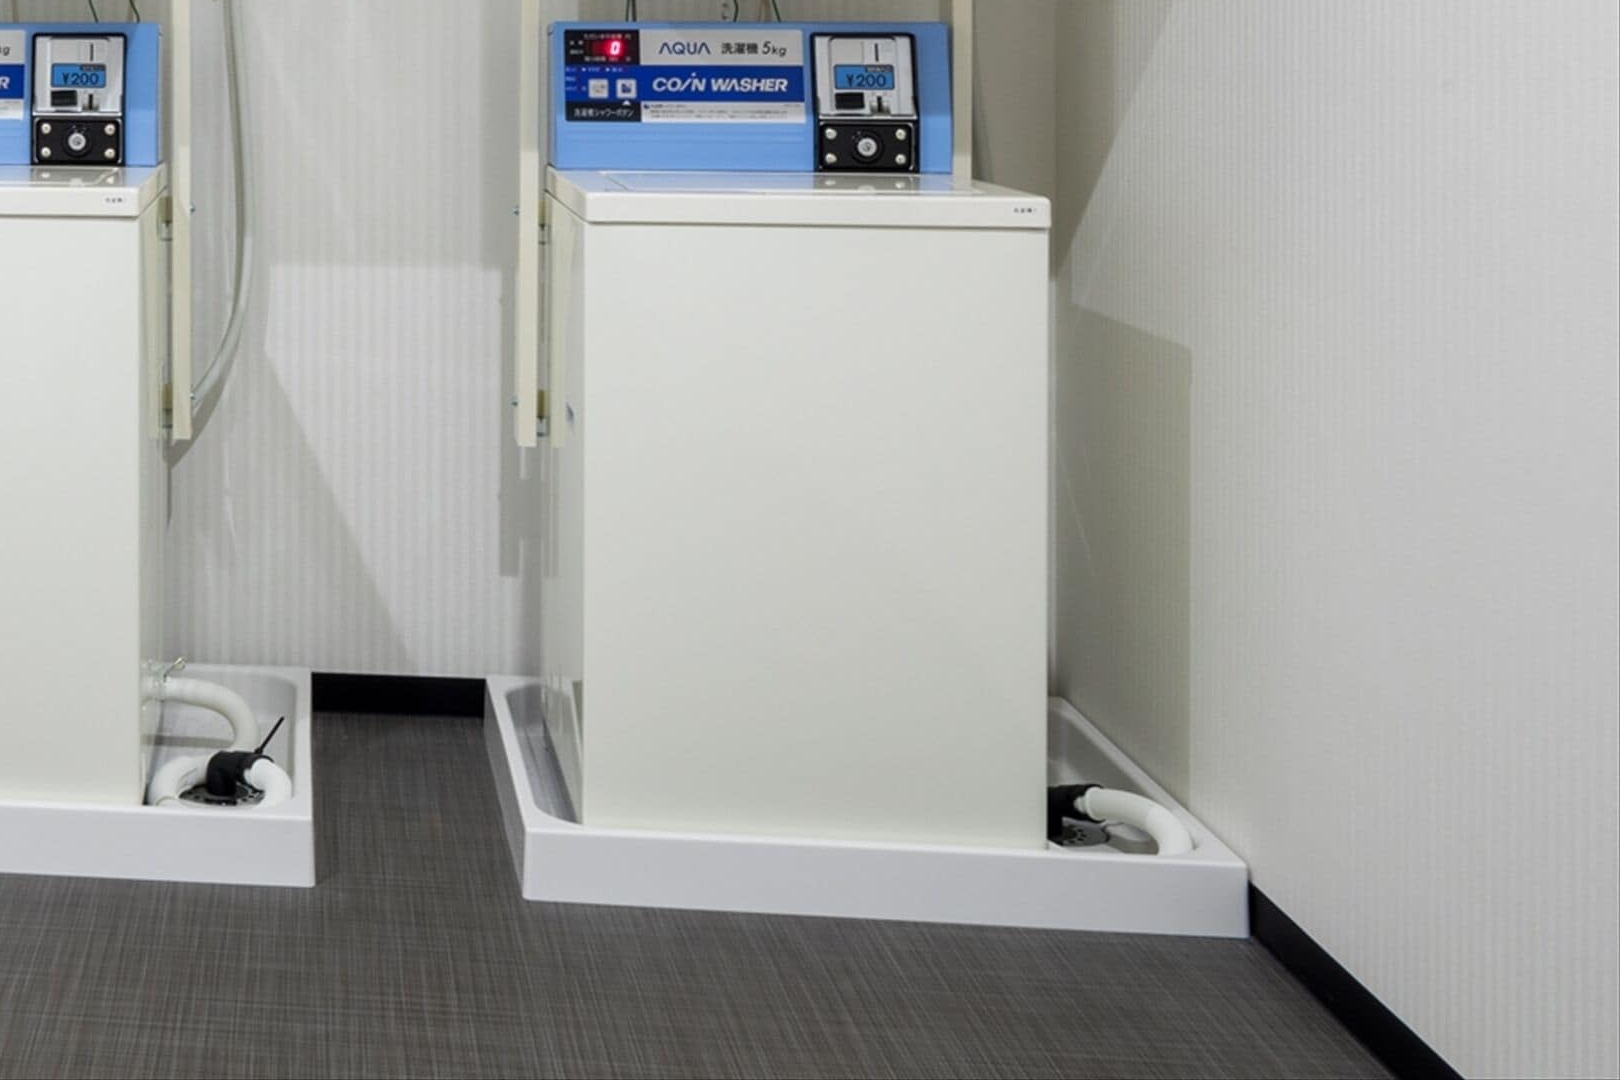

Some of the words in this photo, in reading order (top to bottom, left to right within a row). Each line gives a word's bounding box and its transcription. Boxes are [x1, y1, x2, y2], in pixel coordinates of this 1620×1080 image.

[659, 41, 711, 55] AQUA
[721, 41, 759, 55] 洗濯機
[761, 40, 787, 57] 5kg
[61, 72, 100, 86] ¥200
[710, 78, 789, 93] WASHER
[845, 73, 887, 87] ¥200
